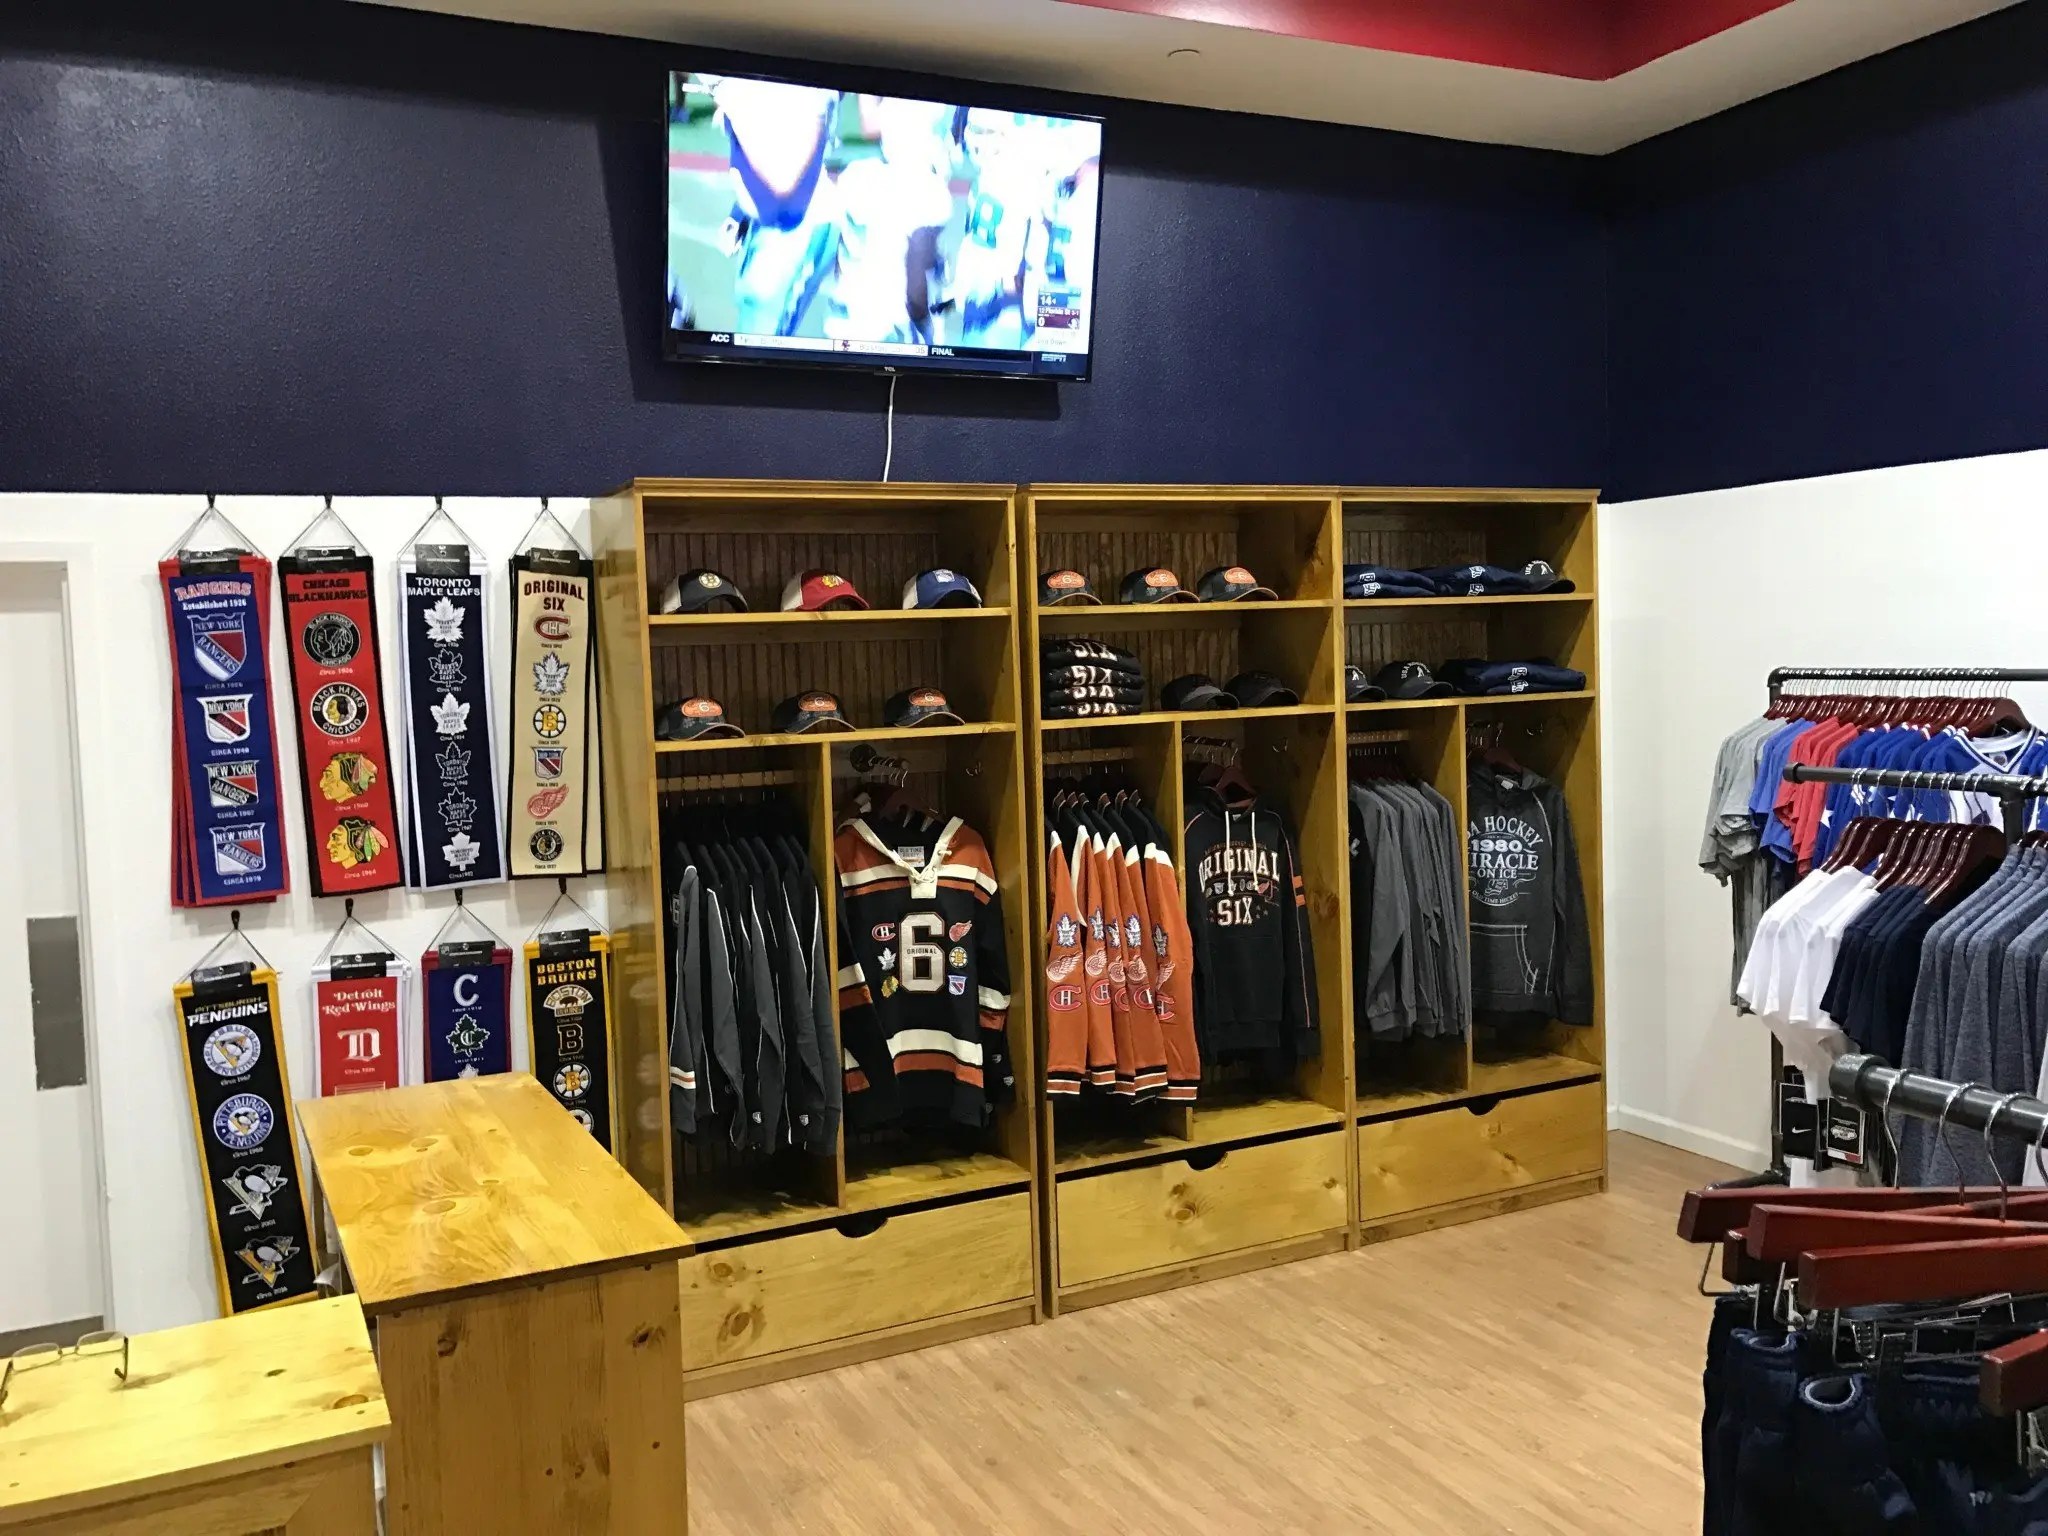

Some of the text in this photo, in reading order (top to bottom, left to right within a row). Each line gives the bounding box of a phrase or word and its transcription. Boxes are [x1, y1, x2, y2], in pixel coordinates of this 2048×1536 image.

[711, 334, 730, 342] ACC
[931, 347, 955, 356] FINAL
[1041, 353, 1067, 362] ESPN
[303, 579, 350, 590] CHICAGO
[415, 577, 472, 588] TORONTO
[1062, 574, 1072, 584] 6
[174, 581, 252, 601] RANGERS
[287, 590, 369, 602] BLACKHAWKS
[408, 586, 480, 596] MAPLE LEAFS
[524, 580, 584, 601] ORIGINAL
[183, 600, 228, 610] Established
[543, 597, 565, 612] SIX
[194, 620, 241, 631] NEW YORK
[197, 636, 238, 671] RANGERS
[1069, 641, 1118, 662] SIX
[1070, 665, 1112, 686] SIX
[313, 686, 366, 712] BLACK HAWKS
[814, 697, 826, 707] 6
[926, 692, 934, 702] 6
[208, 701, 246, 713] NEW YORK
[699, 702, 710, 712] 6
[322, 718, 362, 734] CHICAGO
[543, 711, 558, 731] B
[211, 748, 232, 756] CIRCA
[209, 763, 254, 777] NEW YORK
[211, 780, 249, 805] RANGERS
[217, 811, 238, 819] CIRCA
[216, 829, 260, 842] NEW YORK
[1484, 816, 1544, 848] HOCKEY
[1472, 840, 1522, 853] 1980
[223, 844, 262, 868] RANGERS
[1468, 852, 1538, 870] IRACLE
[1198, 848, 1280, 893] ORIGINAL
[1477, 868, 1518, 878] ON ICE
[224, 878, 244, 886] CIRCA
[1500, 892, 1518, 904] HOCKEY
[1217, 896, 1253, 926] SIX
[899, 912, 945, 994] 6
[537, 958, 596, 974] BOSTON
[538, 970, 597, 986] BRUINS
[334, 988, 383, 1002] Detroit
[453, 974, 479, 1006] C
[545, 986, 592, 1008] BOSTON
[195, 996, 262, 1012] PITTSBURGH
[322, 1000, 396, 1016] Red Wings
[187, 1002, 268, 1027] PENGUINS
[337, 1028, 382, 1062] D
[557, 1024, 584, 1056] B
[566, 1072, 580, 1091] B
[216, 1096, 270, 1127] PITTSBURGH
[225, 1122, 270, 1147] PENGUINS
